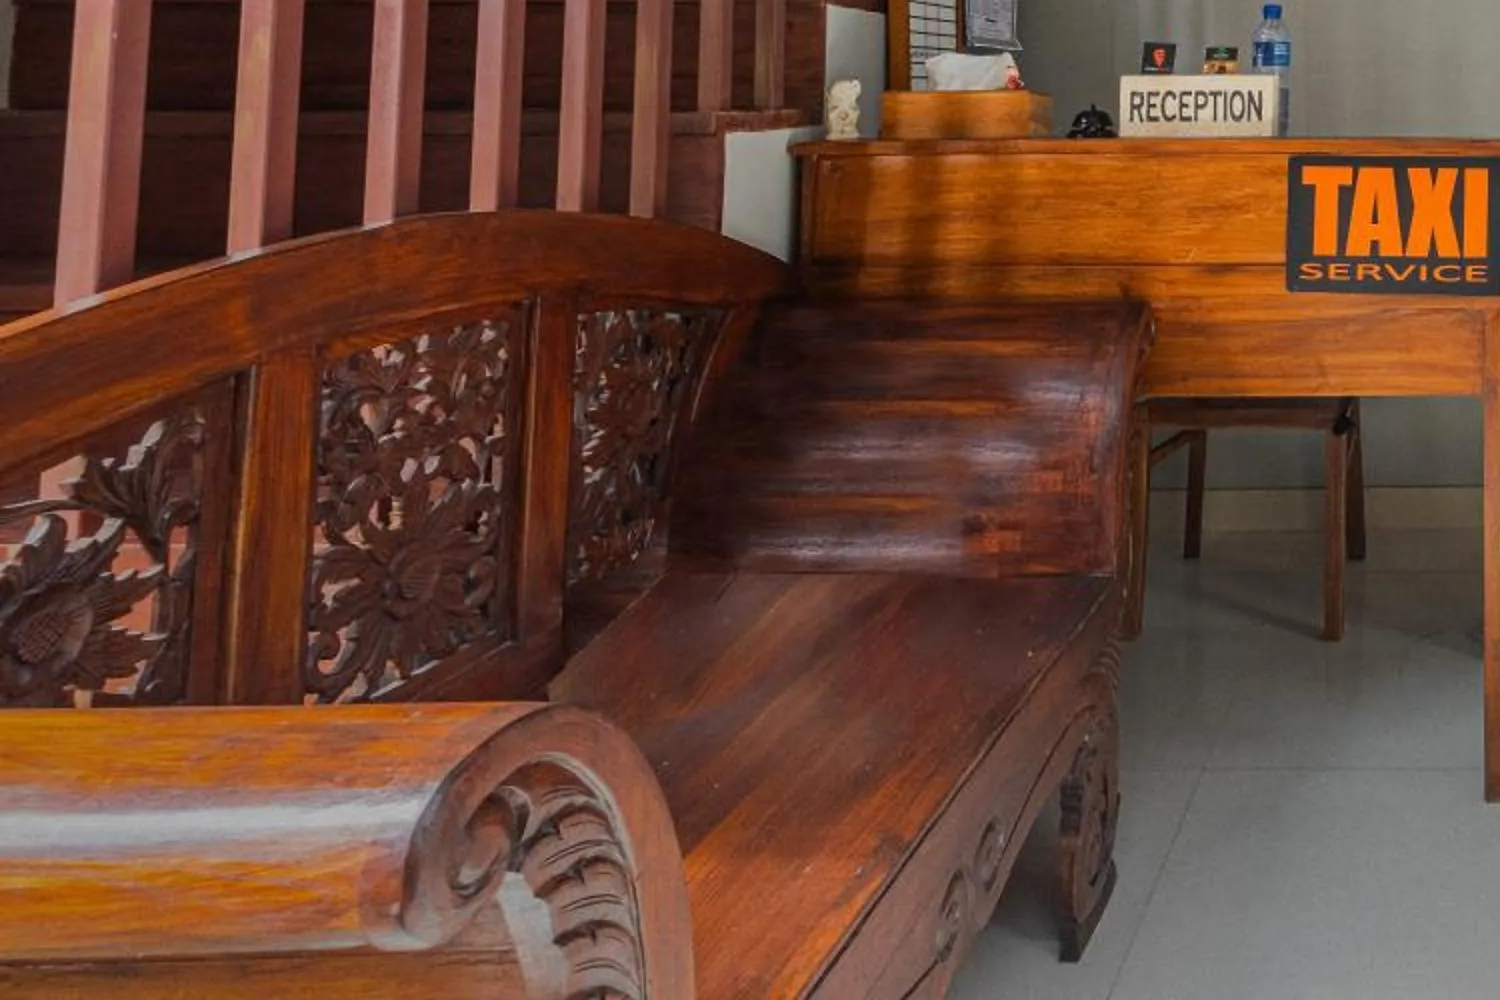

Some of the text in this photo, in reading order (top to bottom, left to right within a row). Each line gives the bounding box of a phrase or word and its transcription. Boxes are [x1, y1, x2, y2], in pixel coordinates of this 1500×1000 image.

[1128, 89, 1264, 124] RECEPTION
[1302, 166, 1490, 259] TAXI
[1299, 263, 1489, 284] SERVICE
